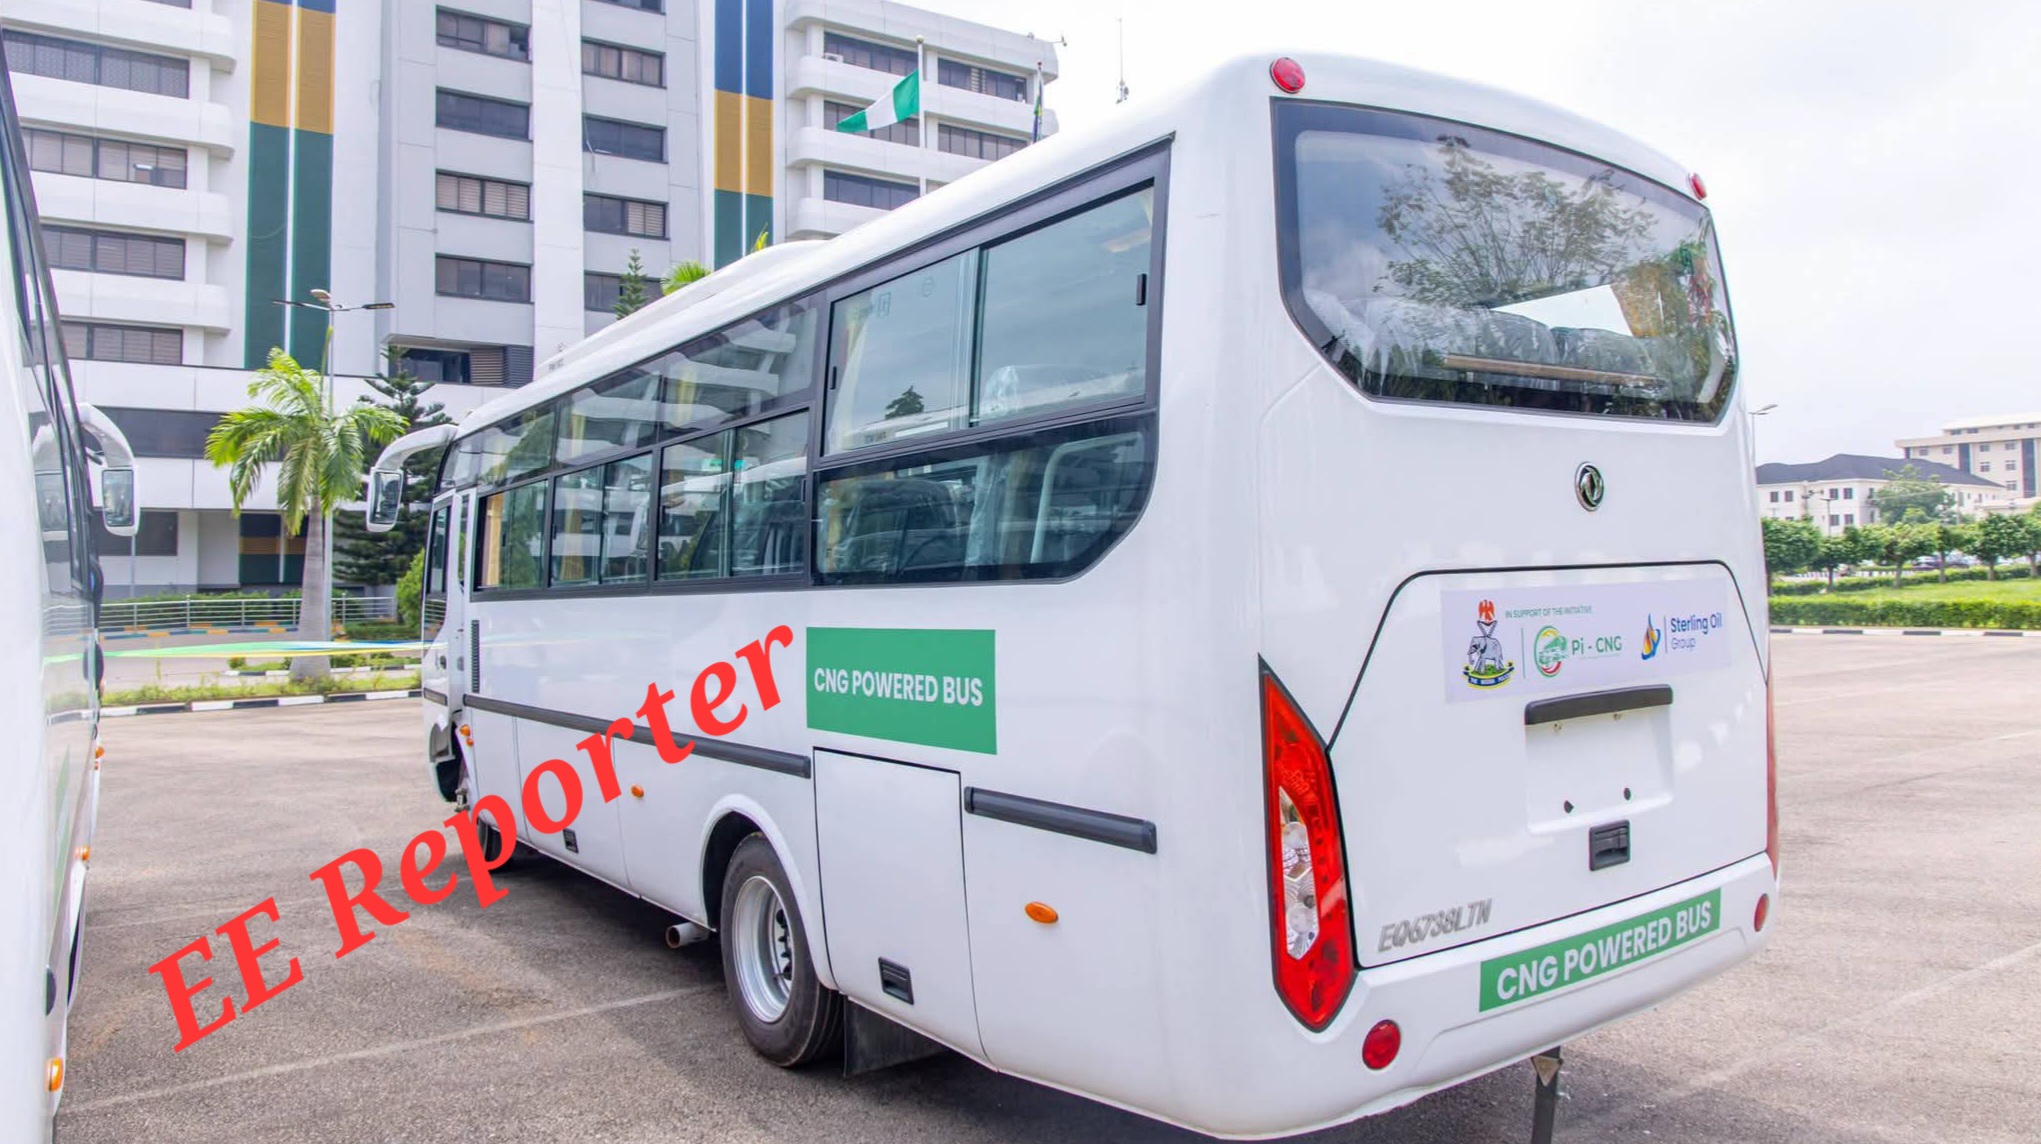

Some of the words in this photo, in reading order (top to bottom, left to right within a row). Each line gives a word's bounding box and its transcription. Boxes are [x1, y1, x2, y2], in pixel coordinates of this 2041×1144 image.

[1671, 614, 1708, 635] Sterling
[1710, 612, 1722, 628] Oil
[1595, 635, 1622, 653] CNG
[1671, 637, 1696, 651] Group
[814, 667, 849, 694] CNG
[852, 670, 938, 703] POWERED
[943, 676, 984, 707] BUS
[1497, 955, 1559, 1000] CNG
[1564, 916, 1673, 981] POWERED
[1676, 901, 1712, 940] BUS
